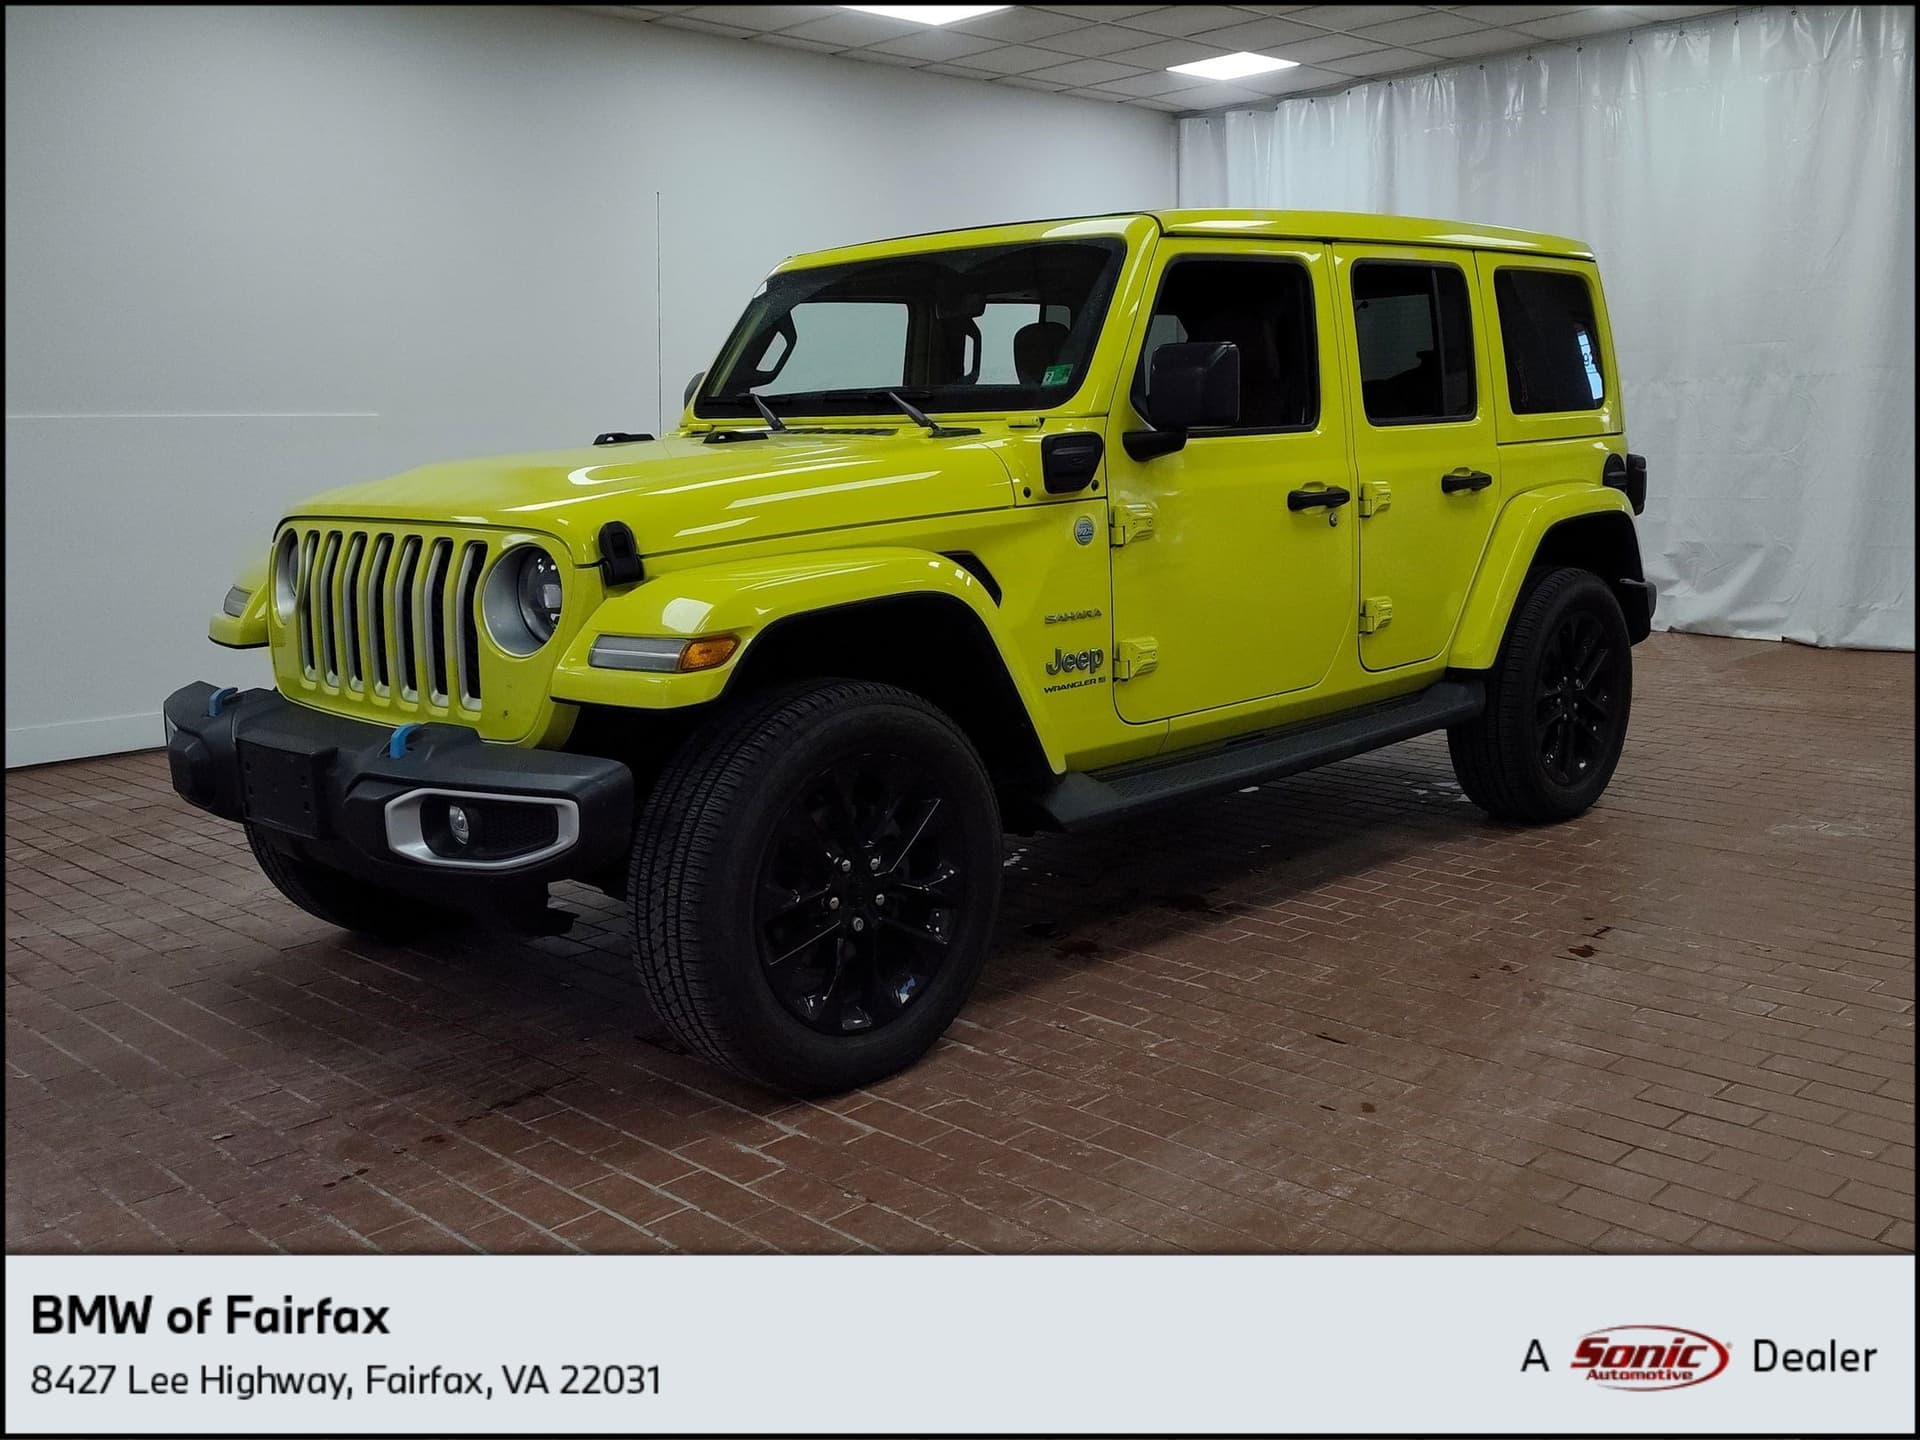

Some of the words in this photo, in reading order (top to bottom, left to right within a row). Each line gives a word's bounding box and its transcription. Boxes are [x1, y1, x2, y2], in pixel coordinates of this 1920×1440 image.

[1045, 608, 1102, 624] SAHARA
[1046, 648, 1104, 675] Jeep
[1043, 678, 1097, 694] WRANGLER
